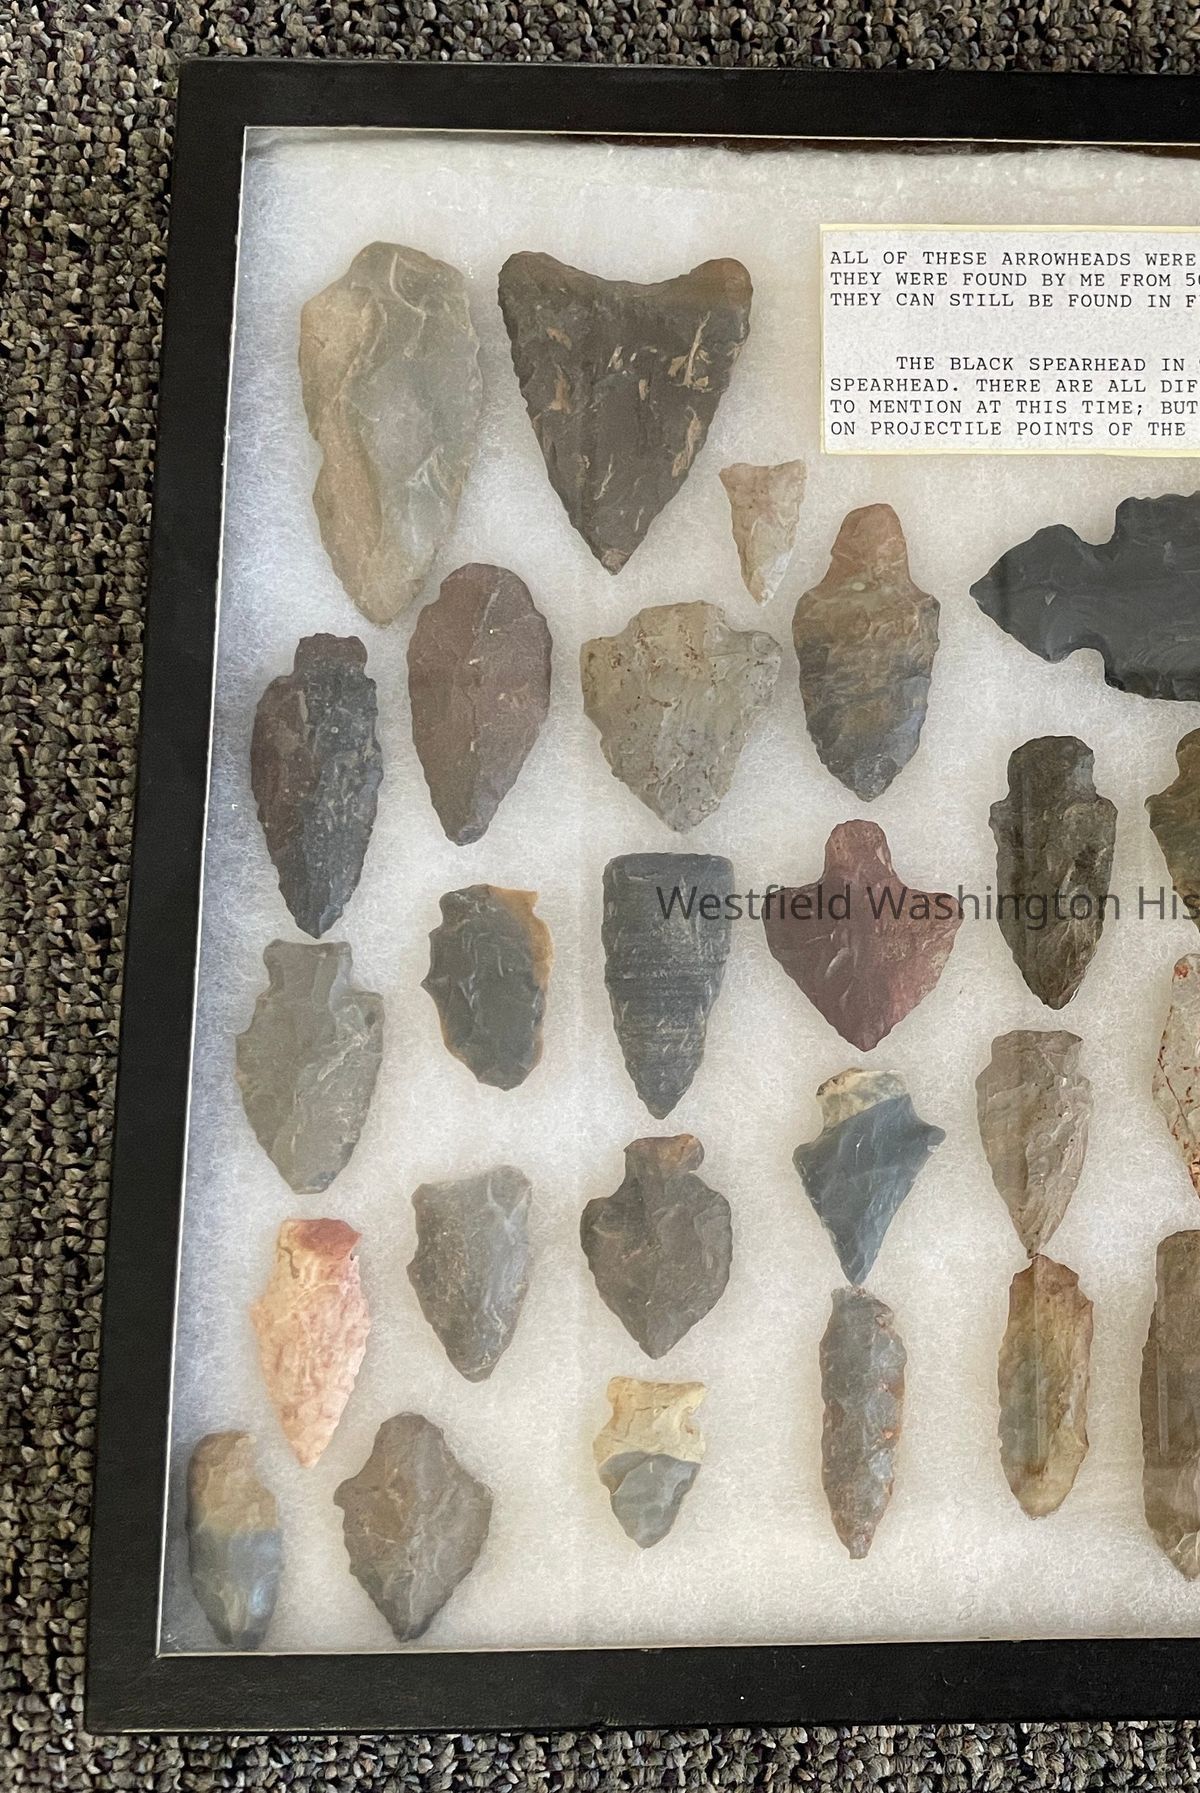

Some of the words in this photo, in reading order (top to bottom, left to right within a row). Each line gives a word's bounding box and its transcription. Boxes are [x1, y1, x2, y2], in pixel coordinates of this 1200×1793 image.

[829, 250, 869, 265] ALL
[882, 250, 908, 265] OF
[922, 251, 988, 266] THESE
[1001, 251, 1131, 267] ARROWHEADS
[1144, 252, 1197, 267] WERE
[829, 271, 882, 286] THEY
[895, 271, 948, 286] WERE
[962, 272, 1028, 287] FOUND
[1040, 272, 1067, 287] BY
[1079, 273, 1105, 287] ME
[1119, 273, 1172, 287] FROM
[829, 292, 882, 307] THEY
[895, 292, 935, 307] CAN
[949, 292, 1014, 307] STILL
[1027, 293, 1054, 308] BE
[1067, 293, 1133, 308] FOUND
[1147, 294, 1172, 309] IN
[895, 355, 935, 371] THE
[949, 356, 1014, 371] BLACK
[1029, 357, 1146, 372] SPEARHEAD
[1161, 357, 1186, 372] IN
[830, 377, 958, 393] SPEARHEAD.
[975, 378, 1041, 393] THERE
[1055, 378, 1094, 393] ARE
[1107, 378, 1147, 393] ALL
[829, 399, 856, 414] TO
[868, 399, 962, 414] MENTION
[975, 399, 1002, 414] AT
[1015, 399, 1067, 415] THIS
[1081, 399, 1143, 416] TIME;
[1160, 400, 1199, 415] BUT
[830, 421, 856, 436] ON
[869, 420, 1002, 436] PROJECTILE
[1016, 421, 1094, 436] POINTS
[1108, 421, 1134, 437] OF
[1147, 421, 1186, 437] THE
